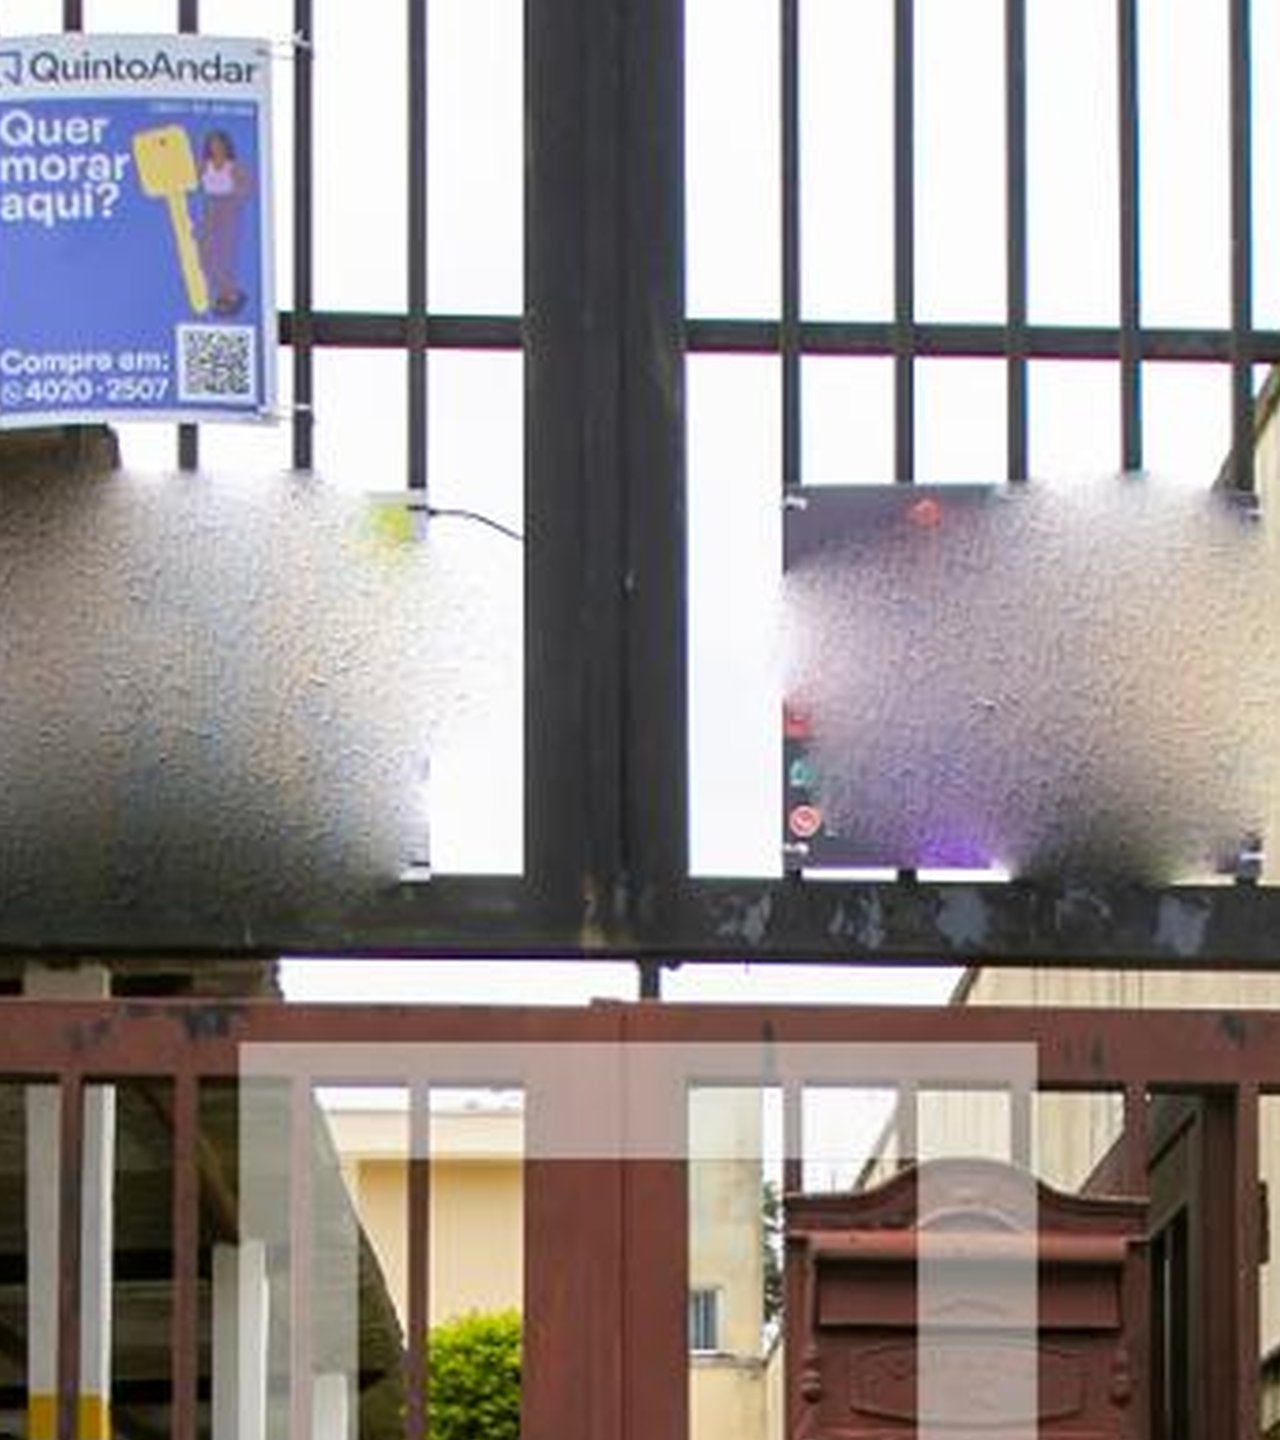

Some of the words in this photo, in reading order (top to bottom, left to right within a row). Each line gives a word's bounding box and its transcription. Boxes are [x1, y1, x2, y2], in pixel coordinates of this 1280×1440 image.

[29, 50, 258, 85] QuintoAndar
[0, 110, 110, 147] Quer
[0, 153, 131, 182] morar
[0, 183, 120, 227] aqui?
[0, 349, 115, 375] Compra
